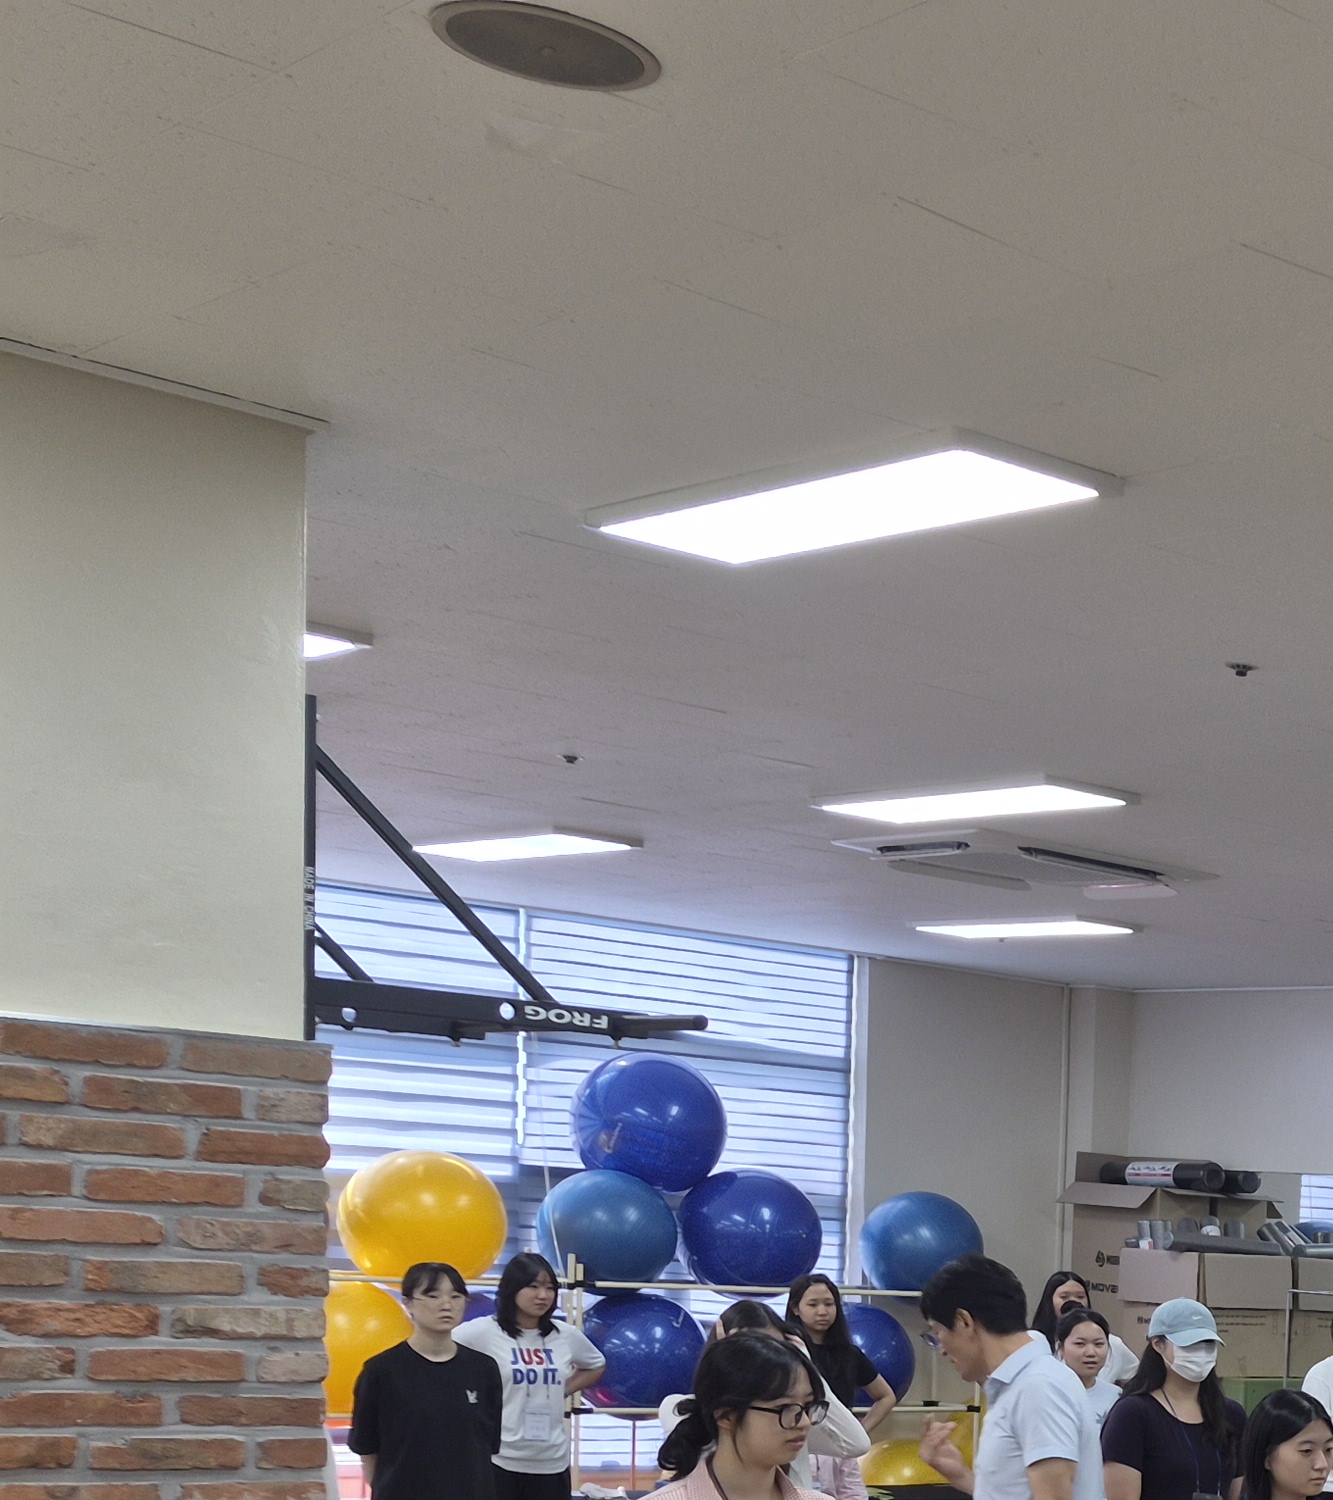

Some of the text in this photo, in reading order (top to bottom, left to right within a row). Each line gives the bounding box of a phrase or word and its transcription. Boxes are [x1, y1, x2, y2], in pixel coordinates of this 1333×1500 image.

[524, 1005, 609, 1030] FROG
[511, 1348, 554, 1366] JUST
[512, 1368, 562, 1386] DO IT.
